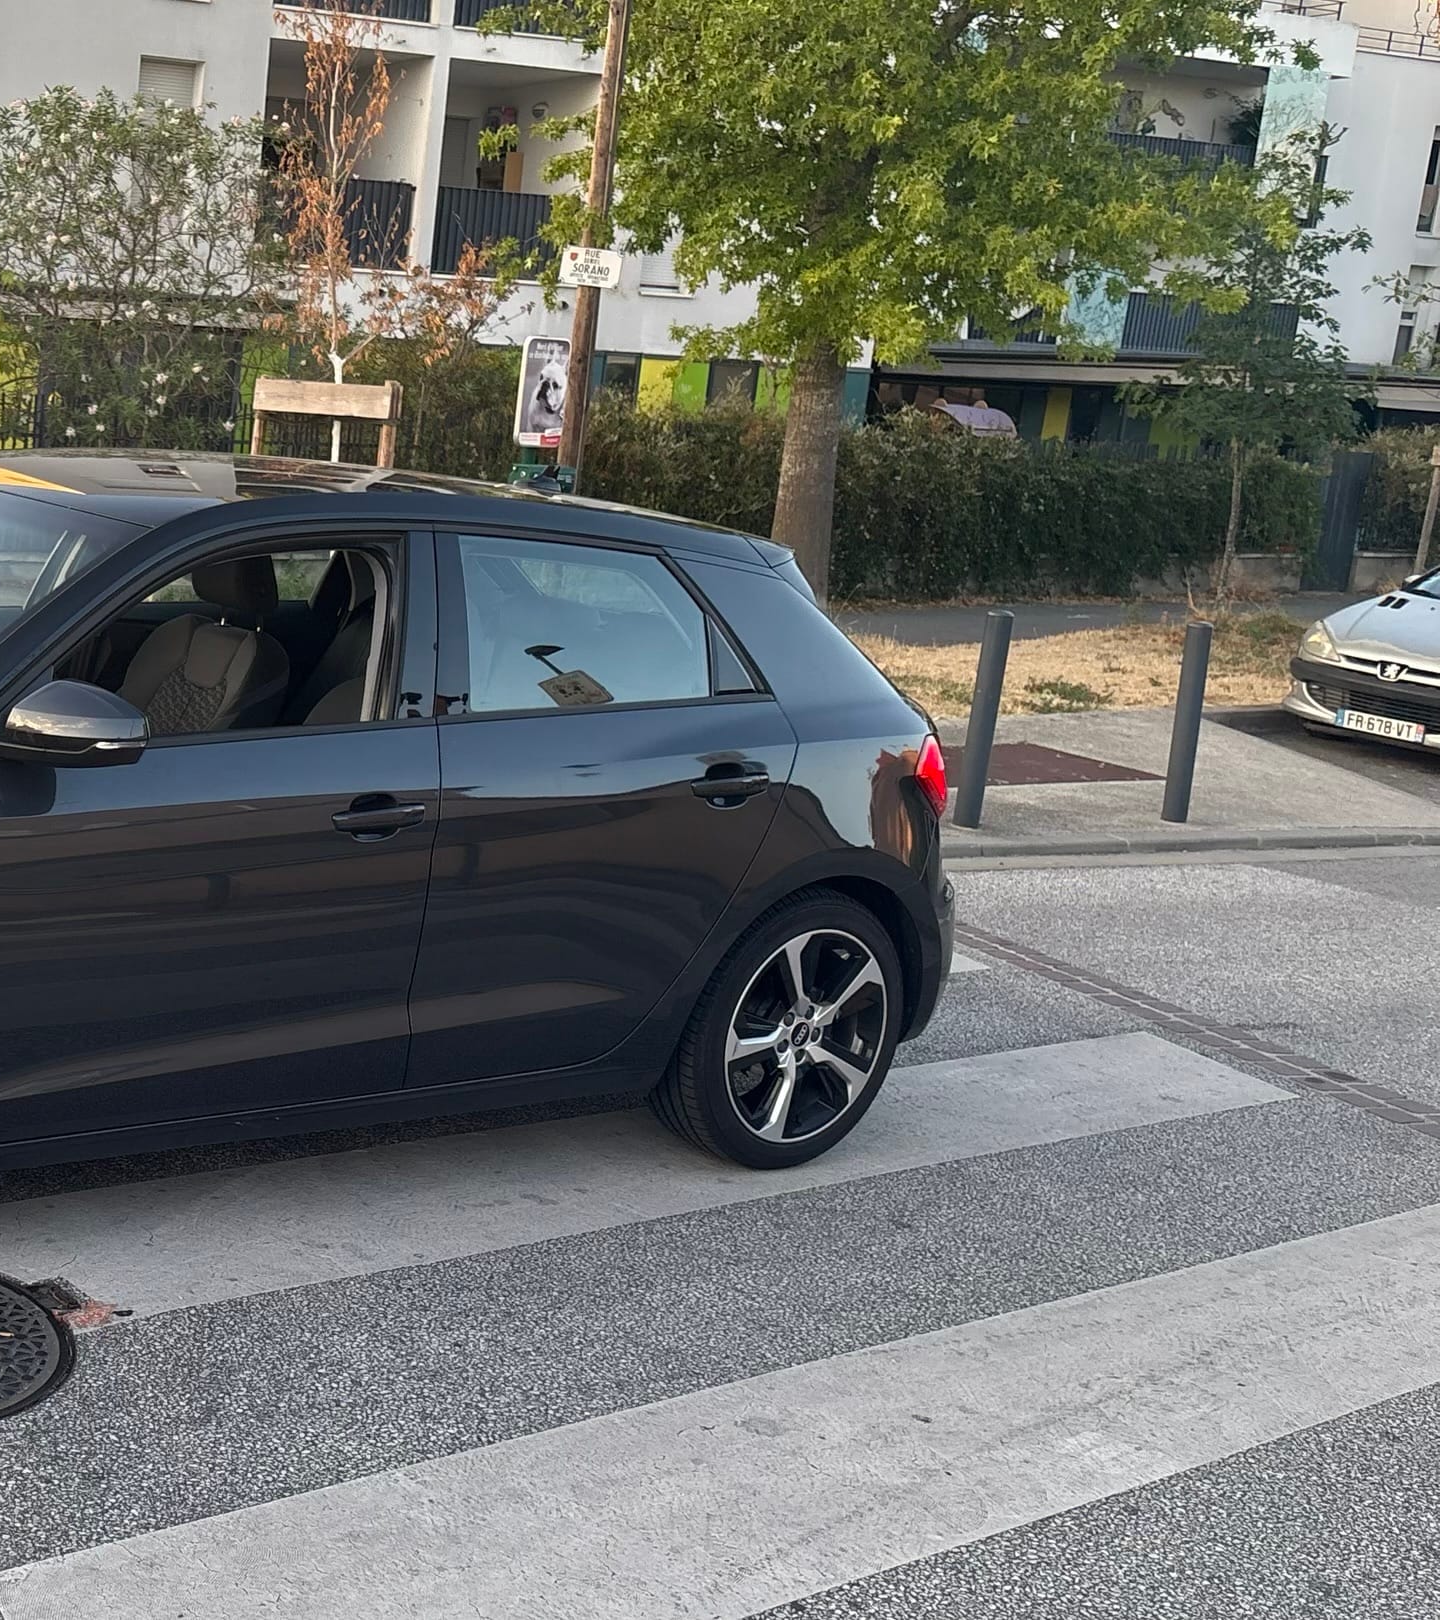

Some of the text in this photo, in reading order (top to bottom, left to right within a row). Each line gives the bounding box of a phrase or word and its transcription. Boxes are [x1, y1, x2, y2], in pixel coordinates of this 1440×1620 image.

[585, 249, 601, 259] RUE
[572, 263, 610, 276] SORANO
[1347, 713, 1413, 738] FR-678-VT
